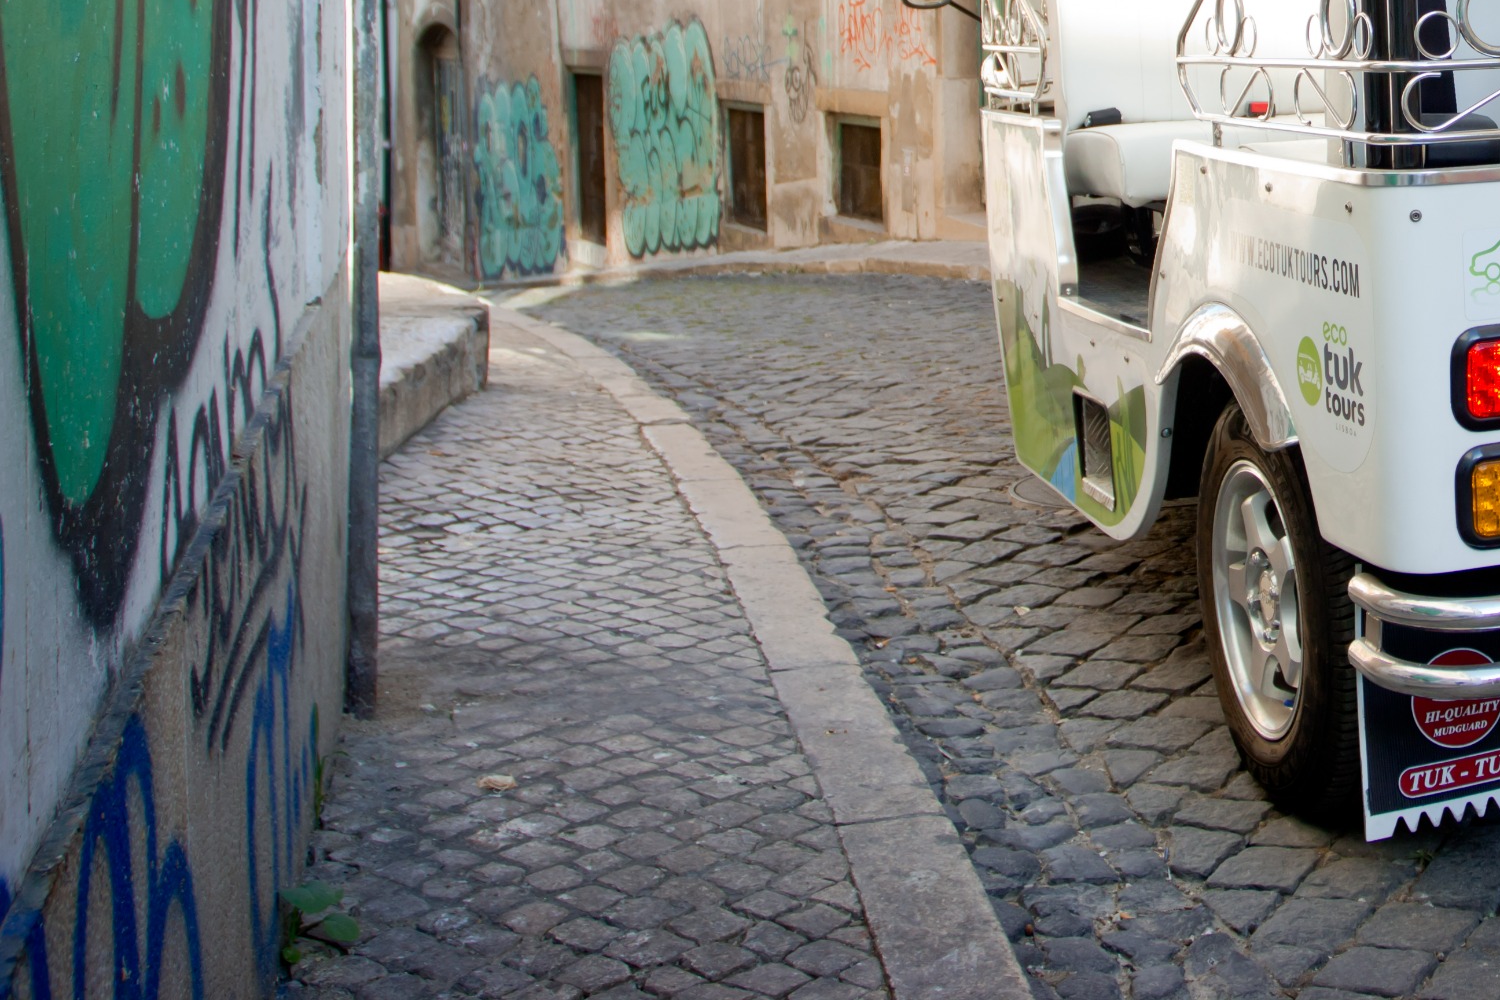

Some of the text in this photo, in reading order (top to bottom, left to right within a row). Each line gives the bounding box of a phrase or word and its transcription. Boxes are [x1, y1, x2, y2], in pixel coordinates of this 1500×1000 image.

[1230, 231, 1360, 299] WWW.ECOTUKTOURS.COM
[1322, 321, 1347, 346] eco
[1323, 342, 1363, 397] tuk
[1325, 386, 1365, 427] tours
[1425, 699, 1500, 724] HI-QUALITY
[1433, 720, 1488, 738] MUDGUARD
